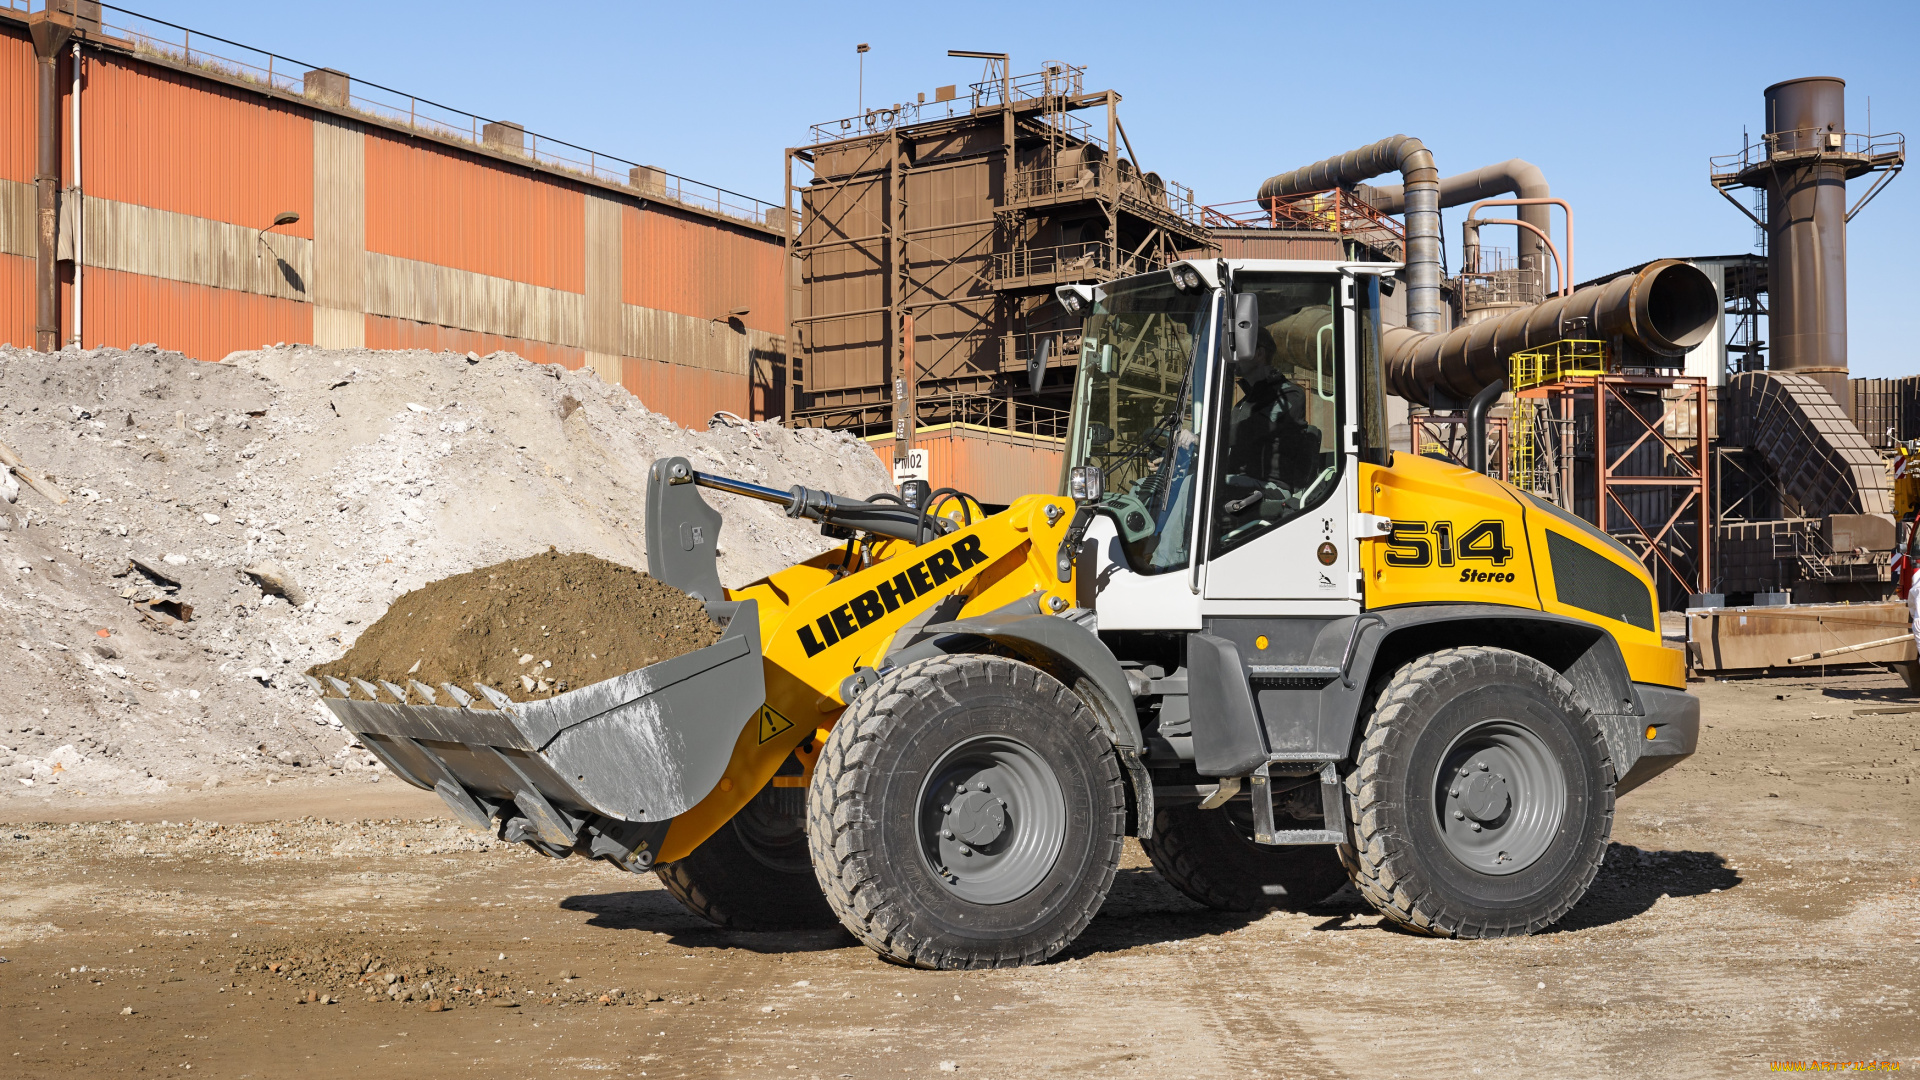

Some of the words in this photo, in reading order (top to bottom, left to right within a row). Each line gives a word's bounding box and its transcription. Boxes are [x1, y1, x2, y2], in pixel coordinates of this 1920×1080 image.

[1384, 519, 1514, 568] 514
[796, 534, 990, 658] LIEBHERR
[1459, 568, 1515, 583] Stereo
